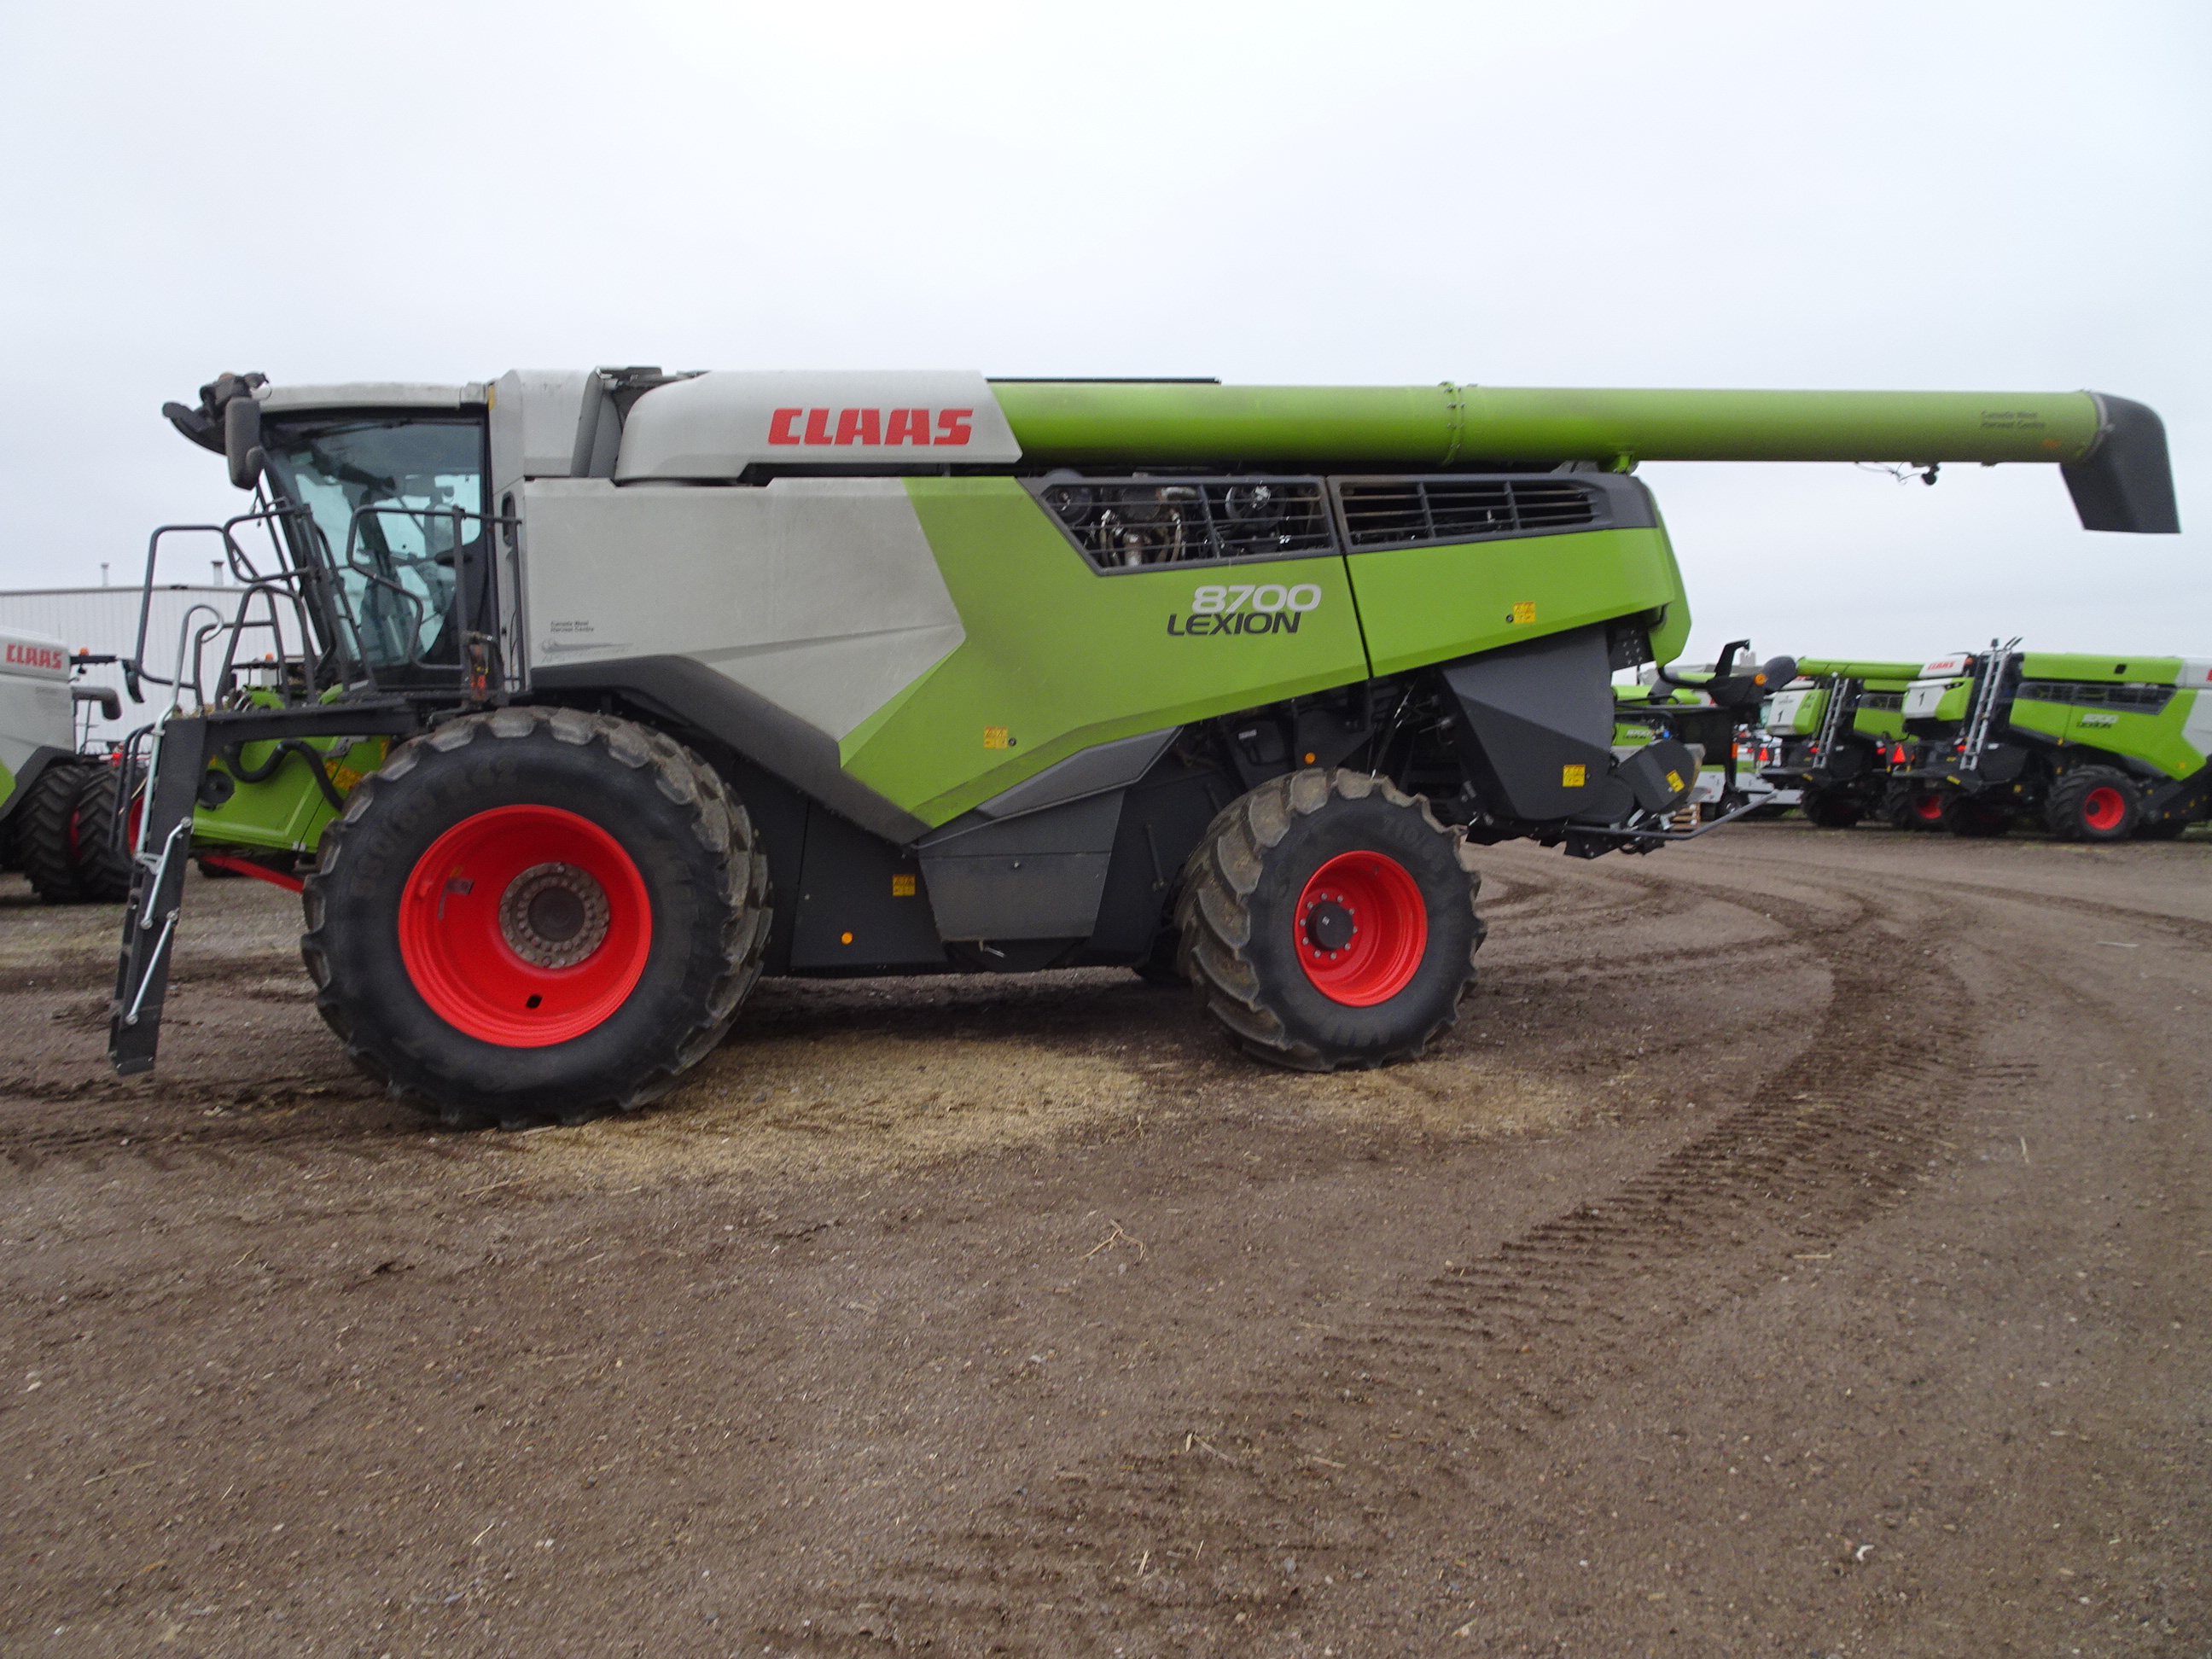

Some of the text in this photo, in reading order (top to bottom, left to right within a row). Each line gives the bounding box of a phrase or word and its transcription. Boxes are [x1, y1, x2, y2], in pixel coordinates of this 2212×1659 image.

[768, 408, 974, 446] CLAAS
[1192, 584, 1322, 614] 8700
[1167, 612, 1301, 636] LEXION
[6, 643, 63, 670] CLAAS
